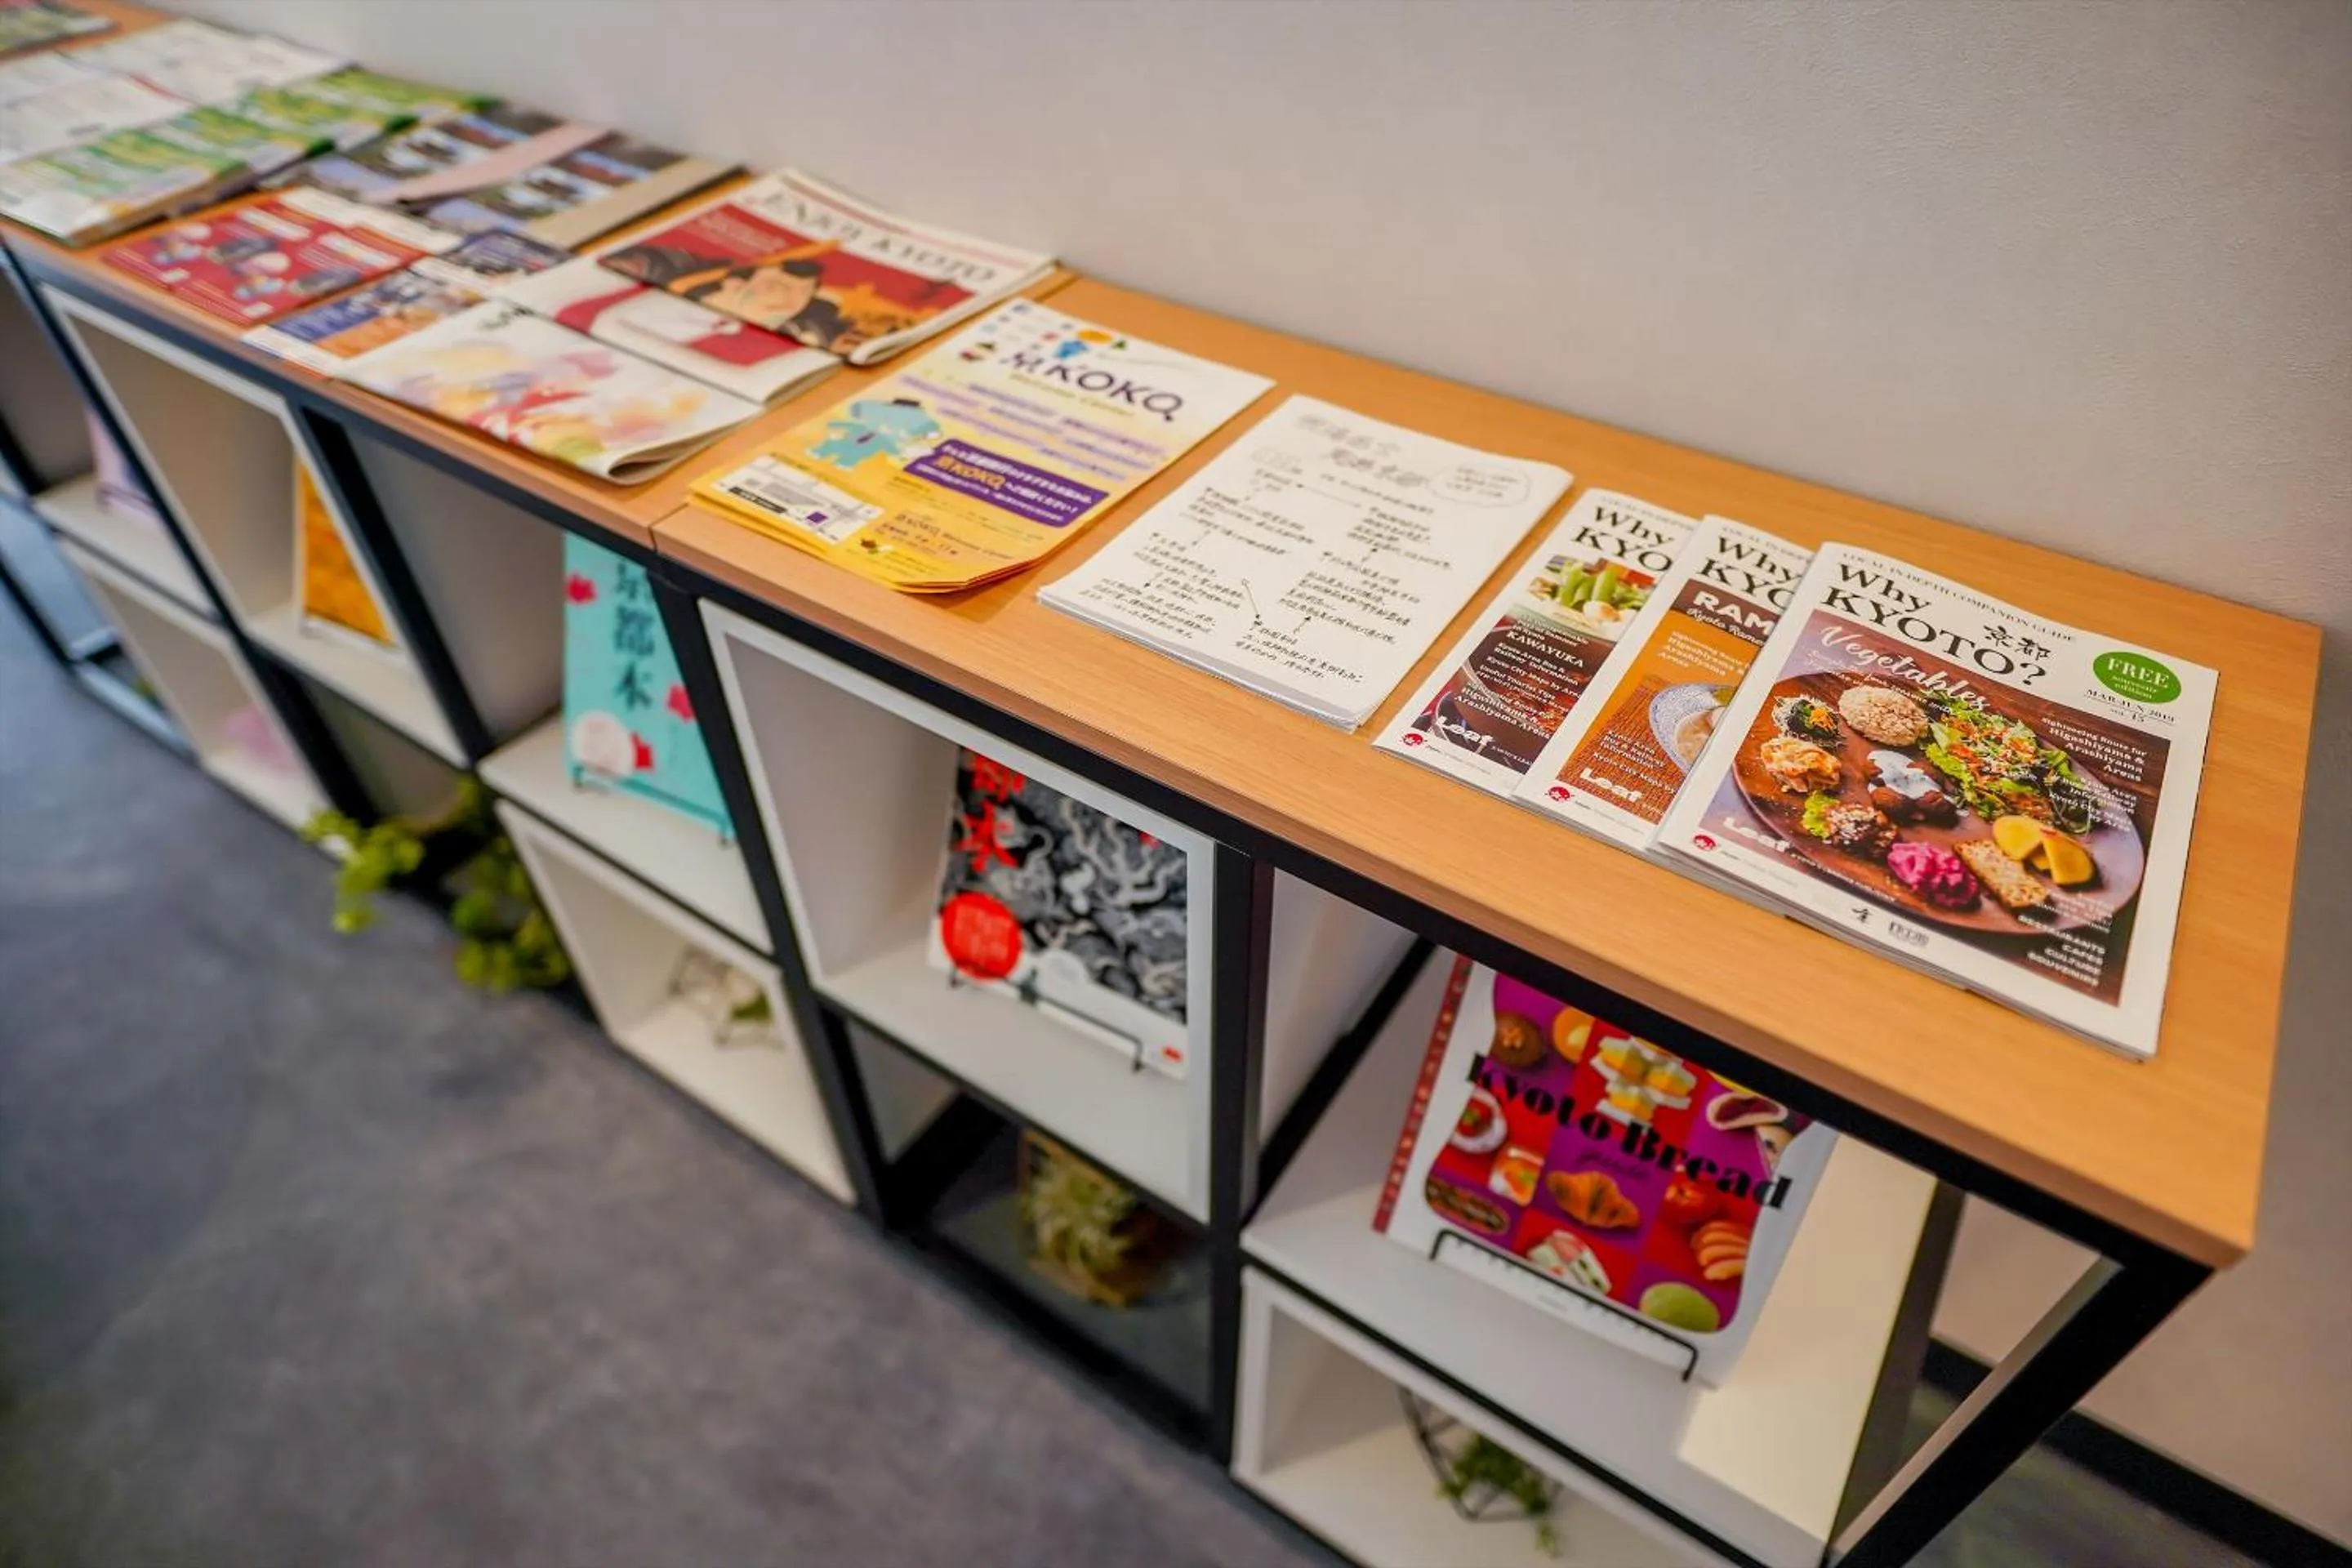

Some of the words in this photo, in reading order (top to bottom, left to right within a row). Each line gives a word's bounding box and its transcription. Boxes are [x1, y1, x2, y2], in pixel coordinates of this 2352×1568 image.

[1593, 506, 1674, 548] Why
[1717, 536, 1802, 585] Why
[1839, 563, 1931, 613] Why
[1686, 608, 1727, 631] Kyoto
[1692, 590, 1775, 635] RAM
[1506, 632, 1584, 668] KAWAYUKA
[1822, 586, 2047, 687] KYOTO?
[1984, 625, 2051, 661] 京都
[1511, 665, 1527, 678] City
[1521, 649, 1541, 663] Area
[1662, 644, 1726, 678] Arashiyama
[1820, 626, 1990, 710] Vegetables
[2107, 658, 2170, 688] FREE
[1454, 696, 1517, 725] Arashiyama
[1435, 715, 1494, 746] Leaf
[2049, 727, 2131, 761] Higashiyama
[2134, 755, 2145, 765] &
[2064, 742, 2143, 774] Arashiyama
[2132, 746, 2148, 757] for
[1580, 767, 1644, 803] Leaf
[2103, 764, 2141, 782] Areas
[1622, 1121, 1793, 1209] Bread
